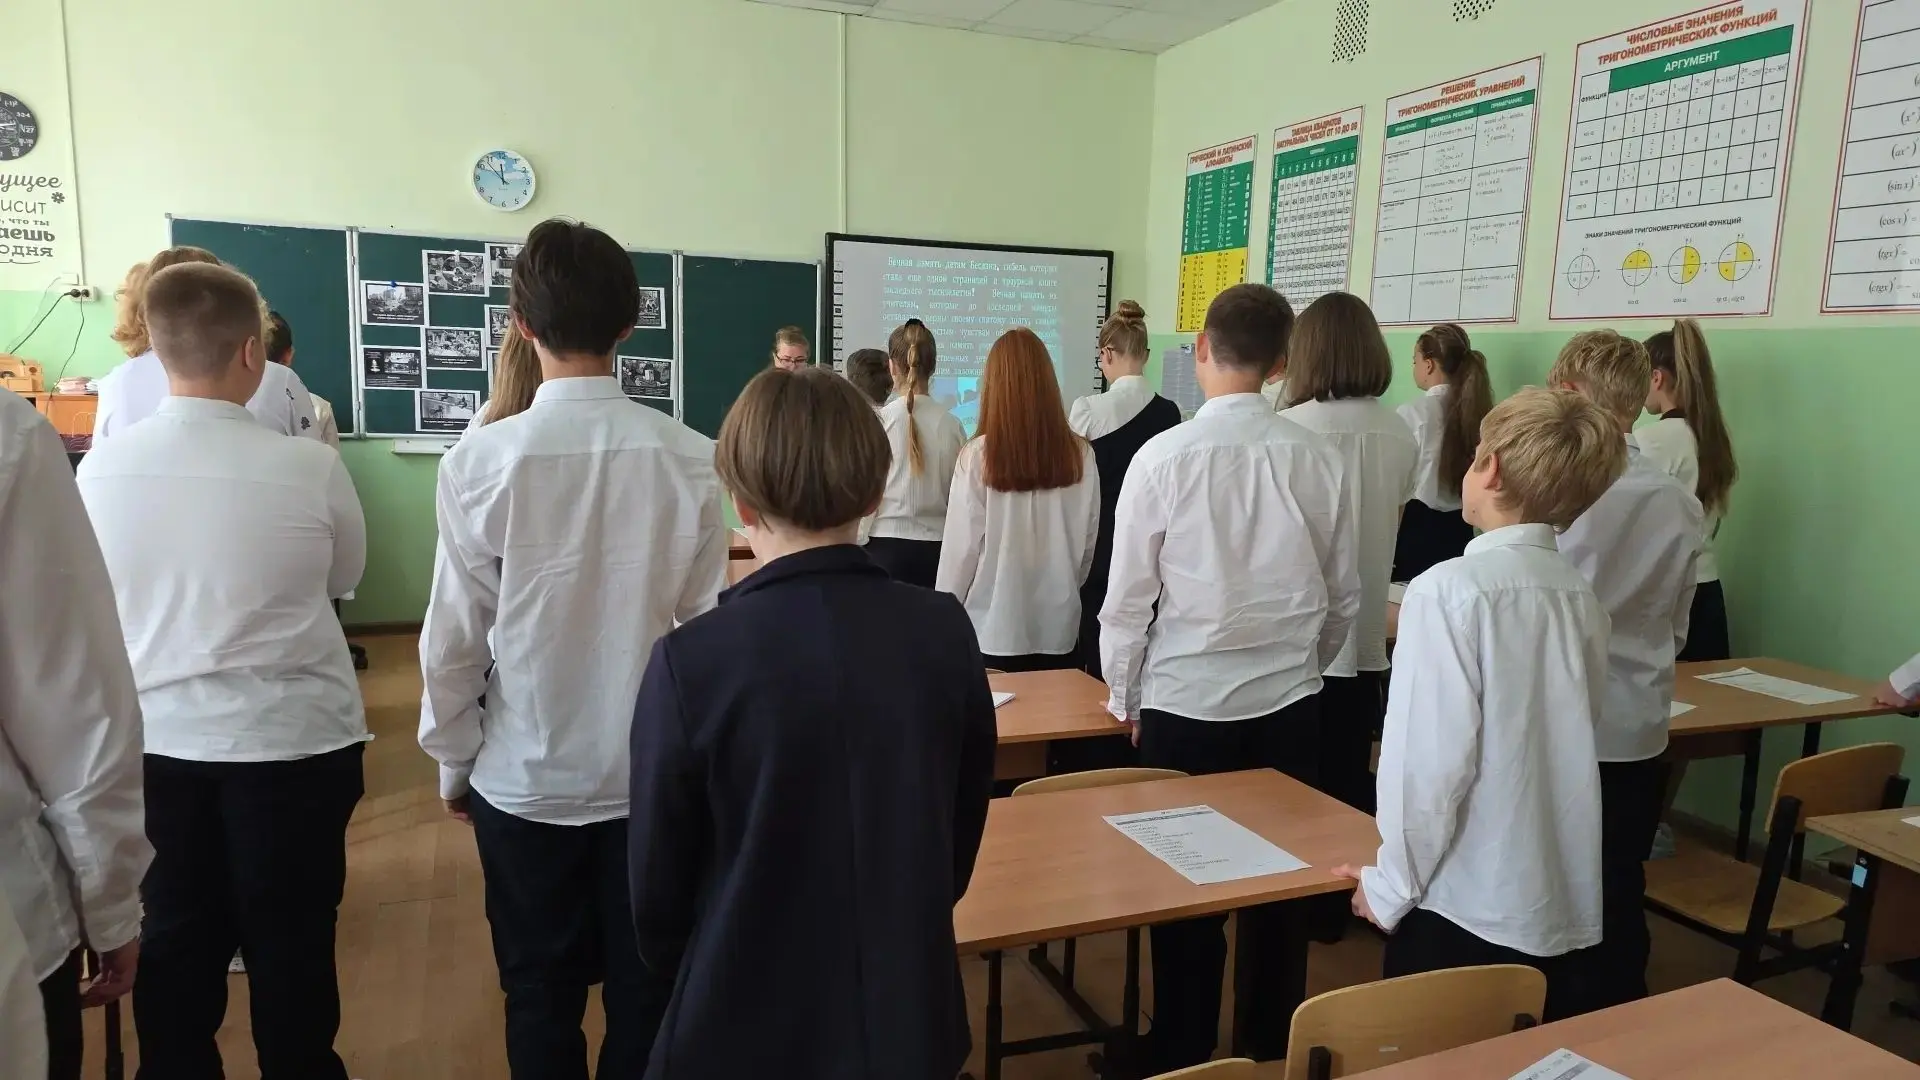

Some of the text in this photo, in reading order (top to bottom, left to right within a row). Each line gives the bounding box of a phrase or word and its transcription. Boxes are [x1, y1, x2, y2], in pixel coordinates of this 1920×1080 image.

[1598, 8, 1778, 66] ТРИГОНОМЕТРИЧЕСКИХ ФУНКЦИЙ
[1626, 5, 1744, 45] ЧИСЛОВЫЕ ЗНАЧЕНИЯ
[1664, 50, 1720, 73] АРГУМЕНТ
[1398, 75, 1526, 118] ТРИГОНОМЕТРИЧЕСКИХ УРАВНЕНИЙ
[1441, 79, 1476, 96] РЕШЕНИЕ
[1708, 216, 1742, 228] ФУНКЦИЙ
